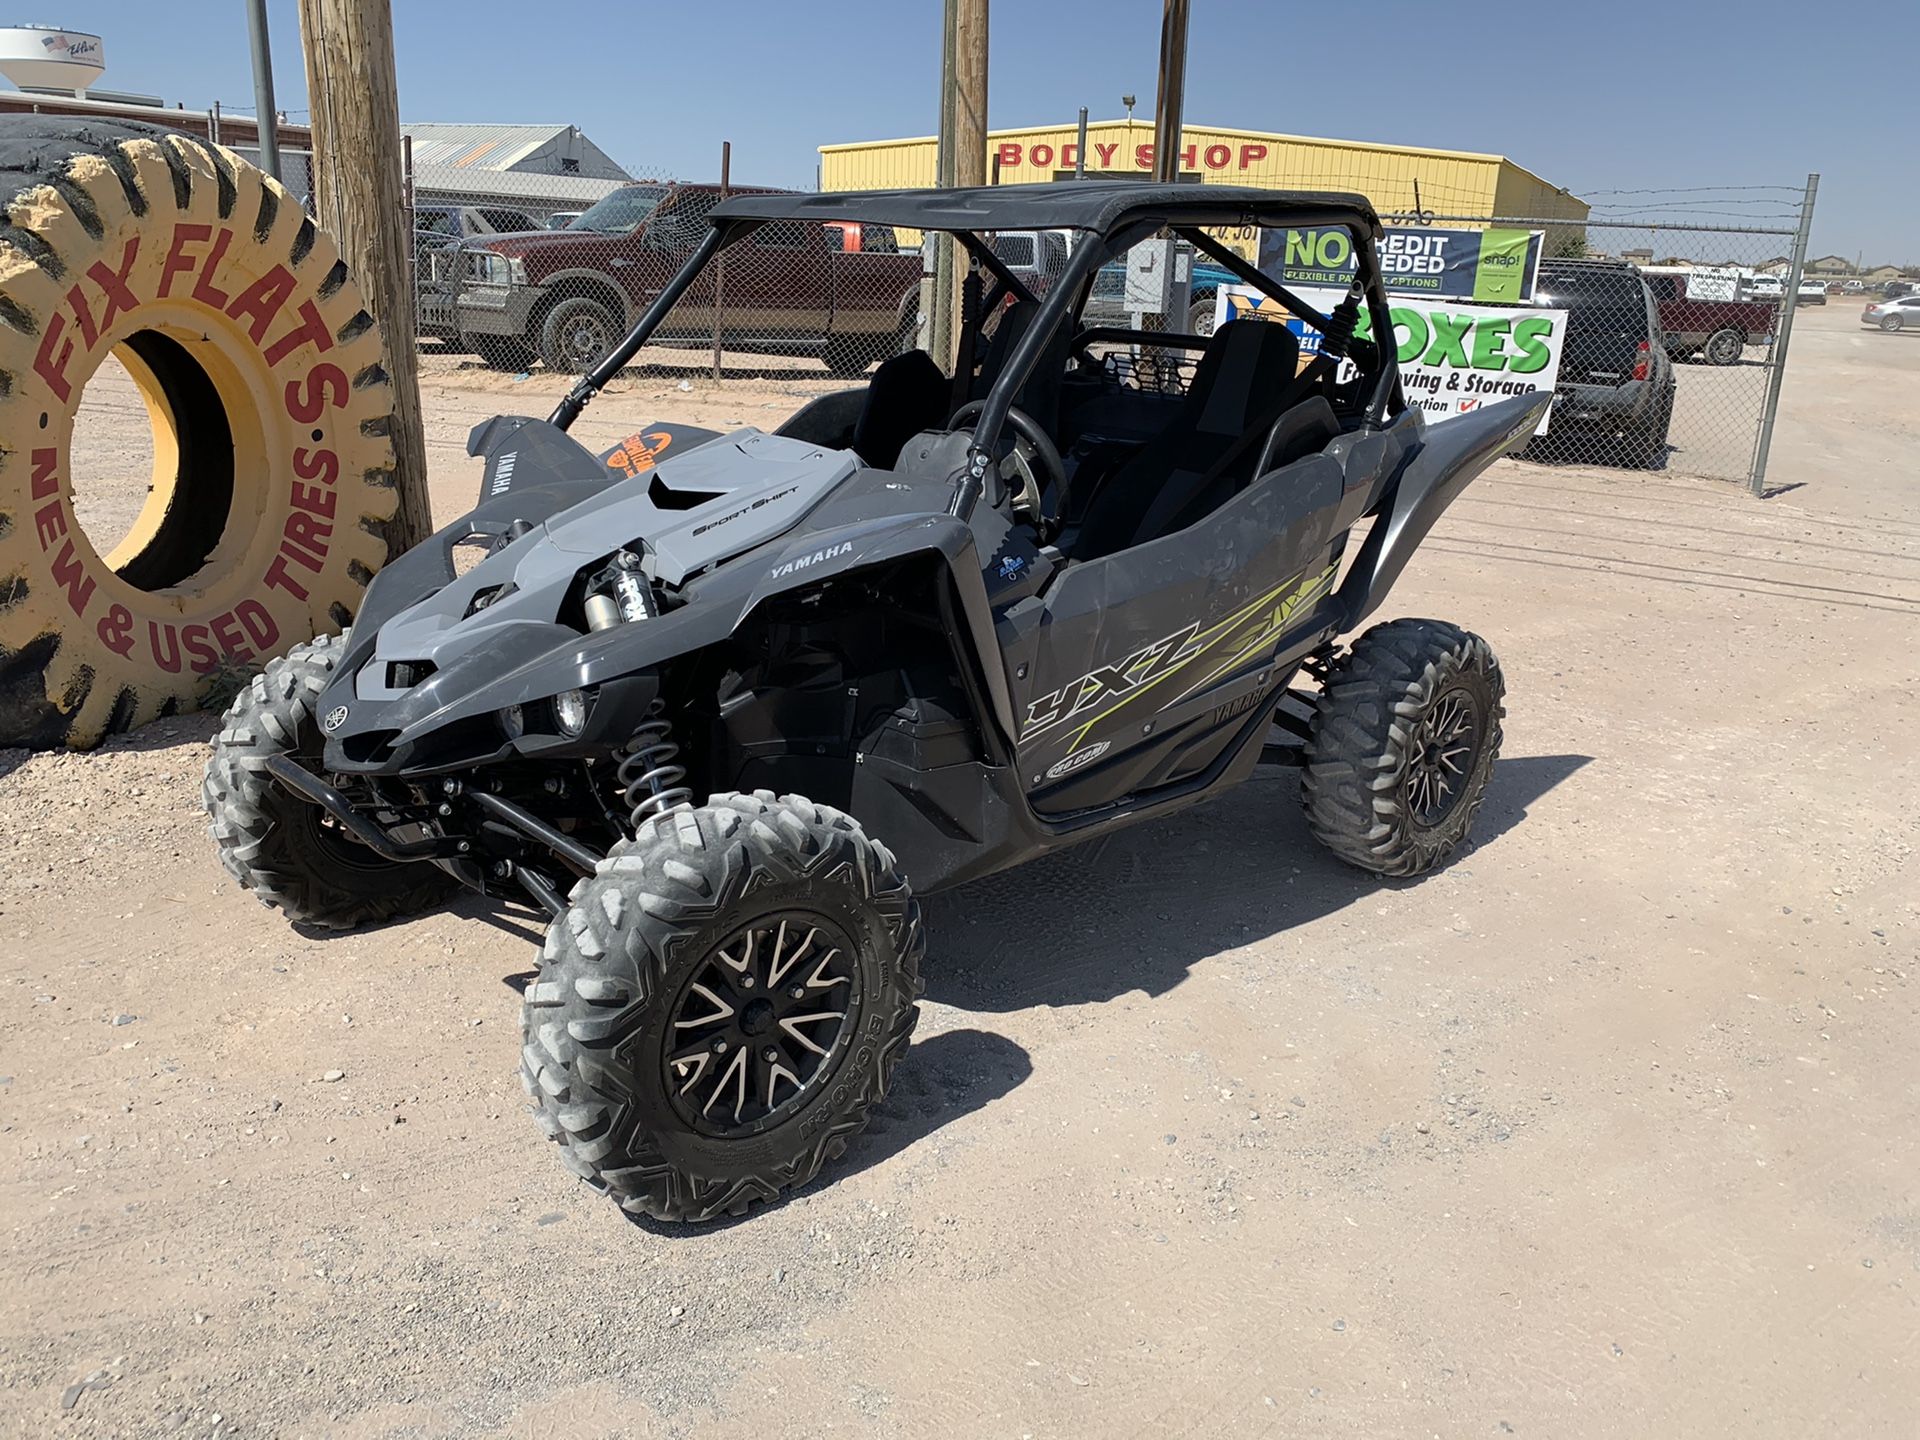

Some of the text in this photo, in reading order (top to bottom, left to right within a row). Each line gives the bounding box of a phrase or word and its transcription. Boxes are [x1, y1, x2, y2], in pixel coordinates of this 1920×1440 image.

[999, 143, 1268, 170] BODY SHOP
[1284, 229, 1349, 268] NO
[1350, 250, 1445, 274] NEDED
[1374, 235, 1449, 256] REDIT
[1484, 255, 1521, 268] snap!
[1286, 271, 1335, 283] FLEXIBLE
[1390, 278, 1438, 288] OPTIONS
[33, 223, 350, 425] FIX FLATS
[1399, 367, 1442, 395] ving
[1446, 372, 1459, 391] &
[1465, 373, 1536, 396] Storage
[1405, 395, 1448, 412] lection
[491, 451, 518, 496] YAMAHA
[692, 485, 800, 537] SPORT SHIFT
[31, 446, 340, 677] NEW & USED TIRES
[771, 541, 853, 579] YAMAHA
[617, 574, 649, 622] FOX
[1213, 687, 1266, 725] YAMAHA
[799, 1013, 884, 1141] BIGHORN
